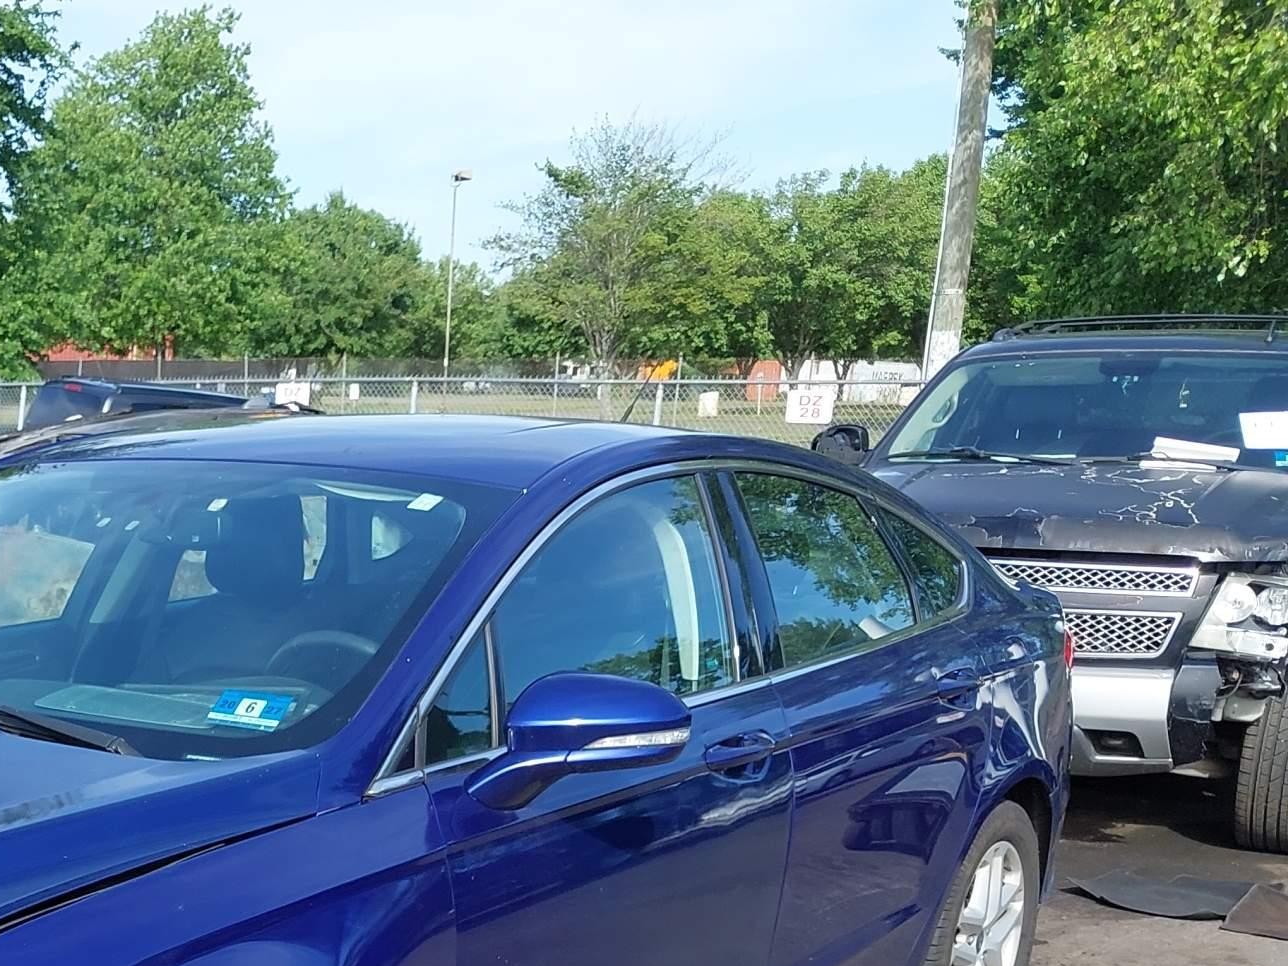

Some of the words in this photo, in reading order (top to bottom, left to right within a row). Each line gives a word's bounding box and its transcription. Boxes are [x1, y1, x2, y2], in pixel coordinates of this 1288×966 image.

[799, 395, 824, 407] DZ
[799, 408, 821, 418] 28
[245, 701, 258, 714] 6
